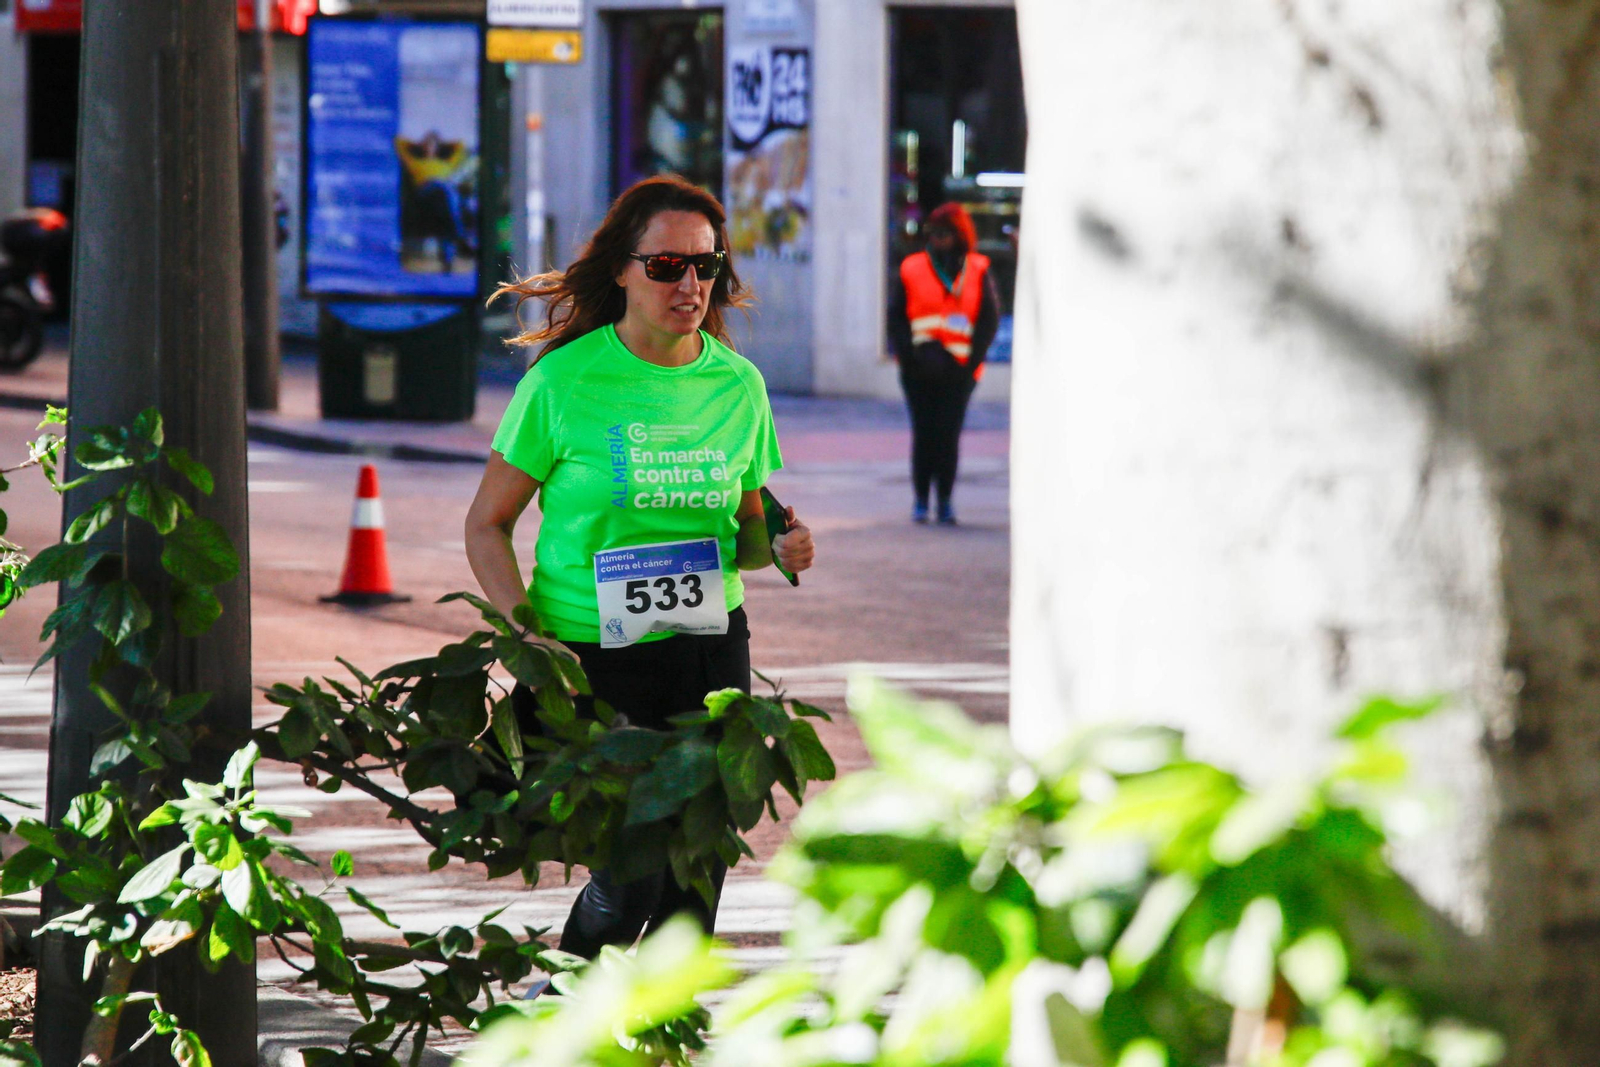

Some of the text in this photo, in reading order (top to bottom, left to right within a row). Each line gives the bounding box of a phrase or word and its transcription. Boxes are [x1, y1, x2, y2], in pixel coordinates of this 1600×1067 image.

[630, 446, 727, 463] En marcha
[605, 423, 628, 509] ALMERÍA
[633, 462, 730, 483] contra el
[633, 486, 732, 509] cáncer
[600, 552, 635, 563] Almería
[600, 558, 673, 573] contra el cáncer
[625, 574, 704, 614] 533
